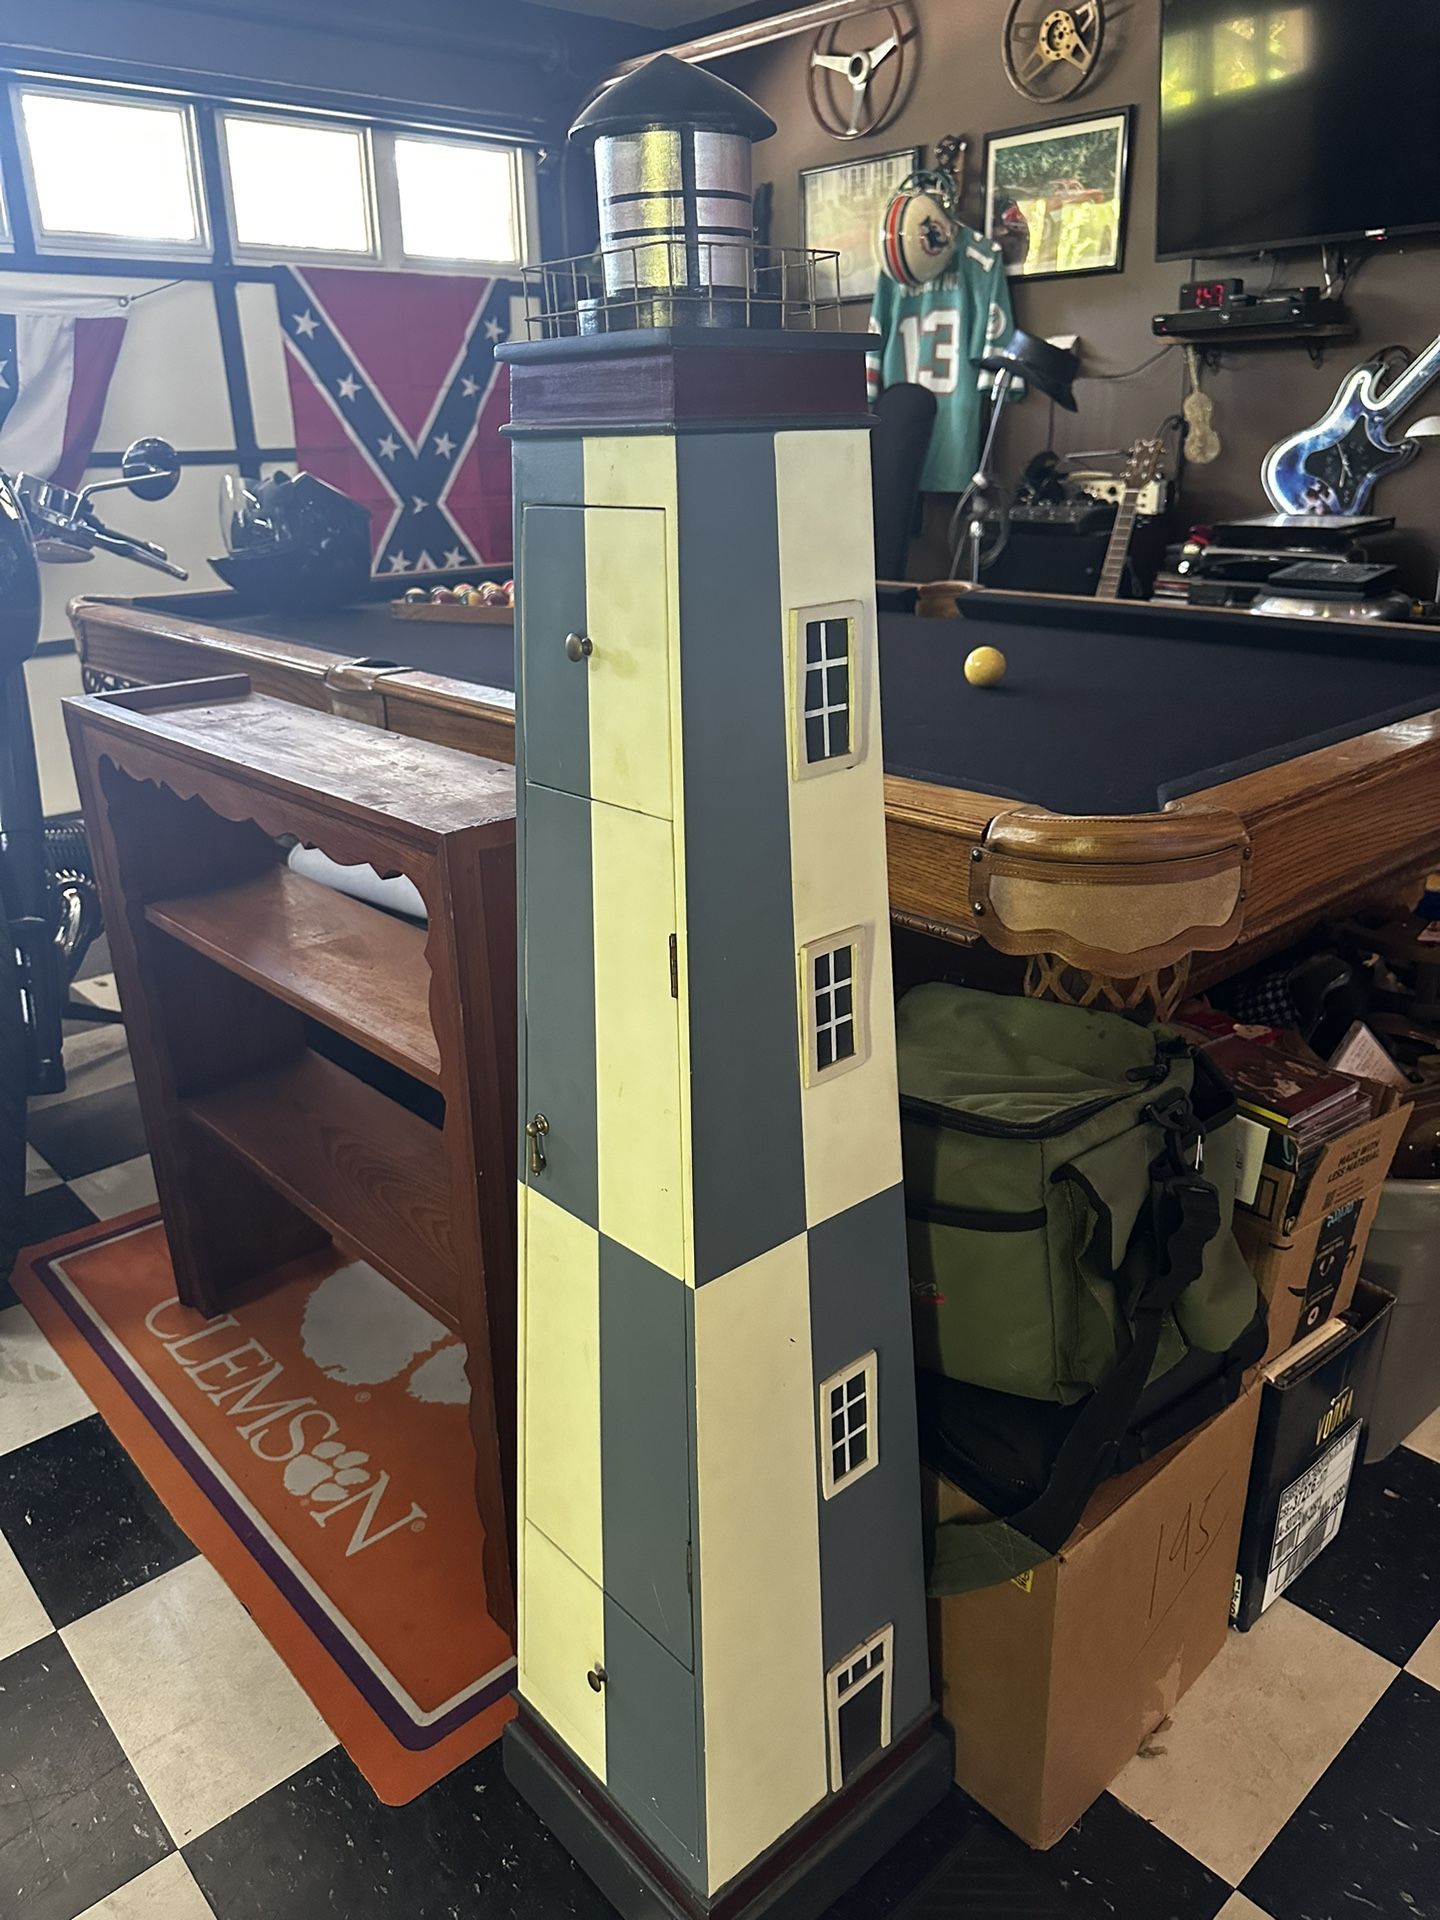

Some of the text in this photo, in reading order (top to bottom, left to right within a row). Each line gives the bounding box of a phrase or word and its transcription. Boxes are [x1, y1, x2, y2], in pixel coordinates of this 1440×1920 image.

[899, 308, 960, 394] 13
[1327, 1167, 1346, 1184] LESS
[1338, 1148, 1360, 1168] MADE
[1315, 1389, 1353, 1446] VODKA
